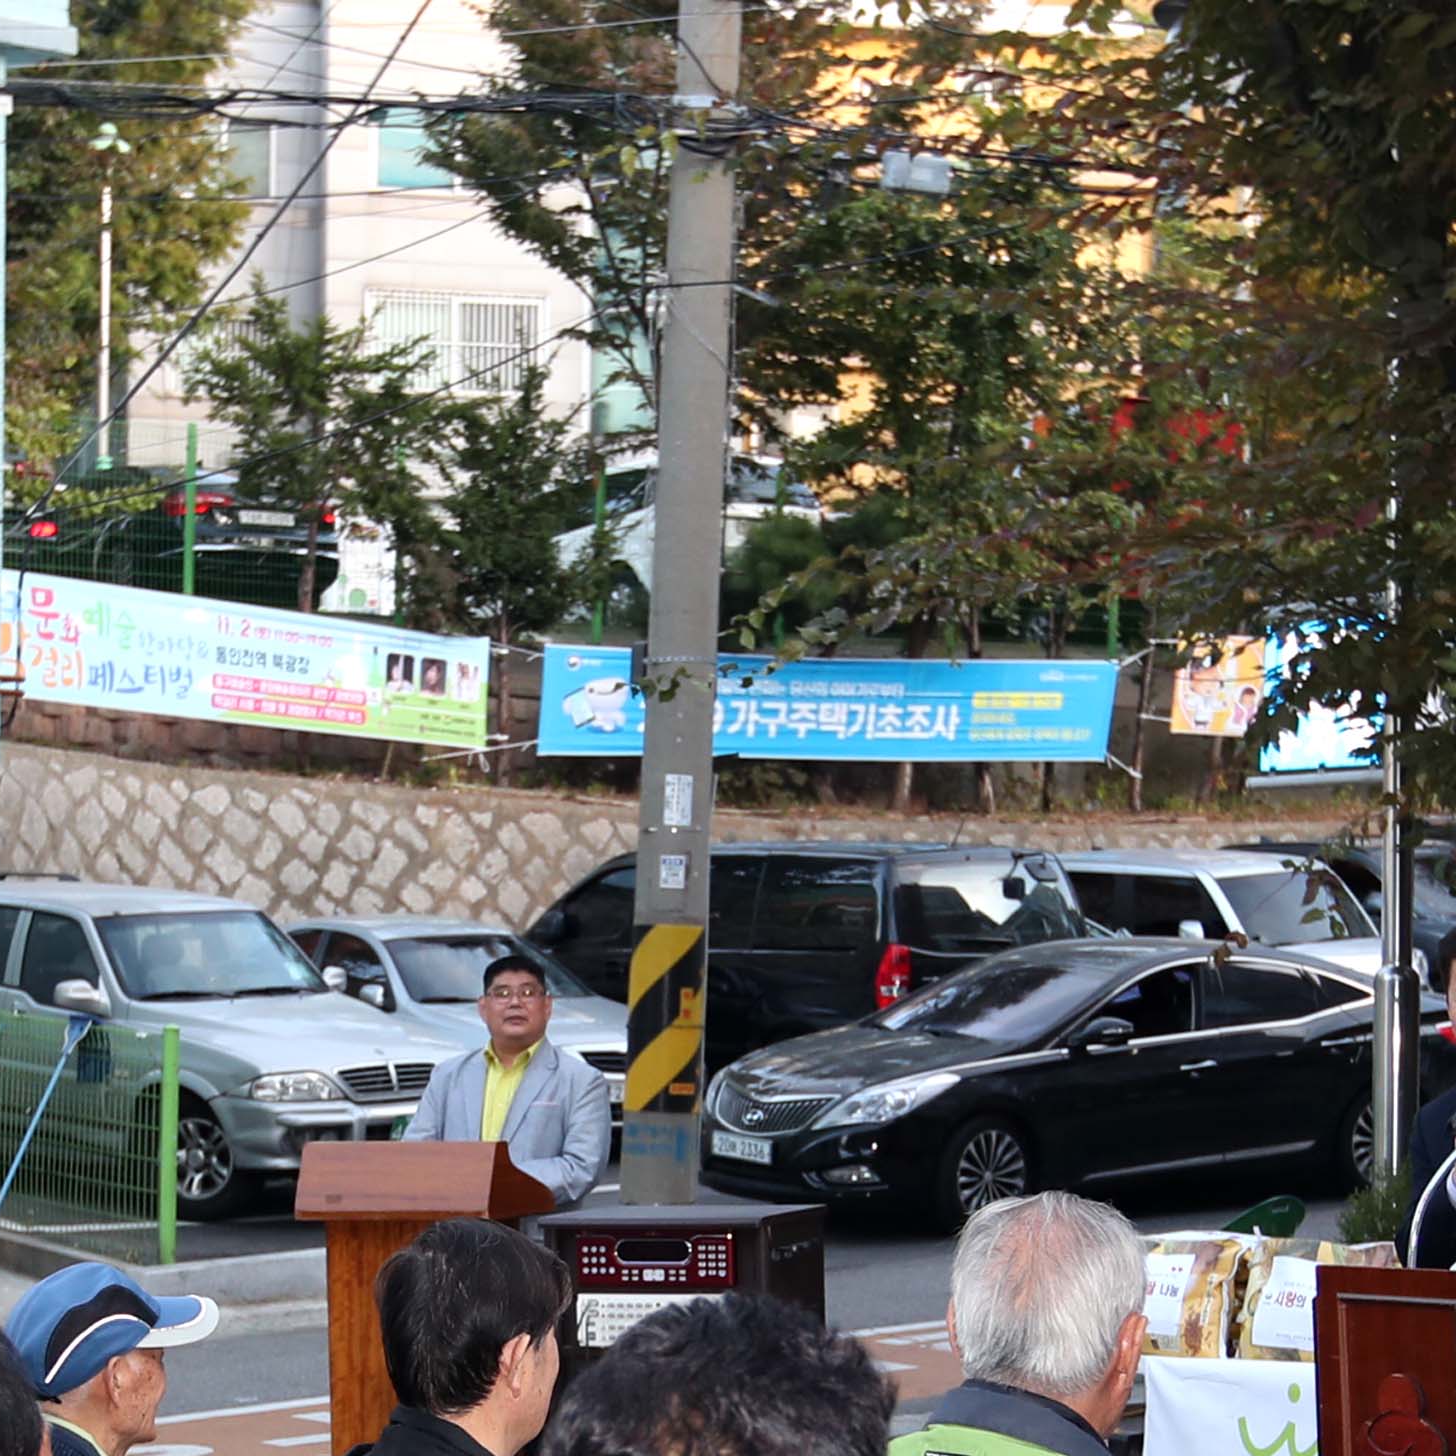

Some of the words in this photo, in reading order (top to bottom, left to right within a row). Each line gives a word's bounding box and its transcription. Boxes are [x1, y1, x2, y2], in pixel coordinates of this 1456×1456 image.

[87, 660, 194, 700] 페스티벌
[727, 700, 960, 741] 가구주택기초조사
[1273, 1290, 1307, 1308] 사랑의
